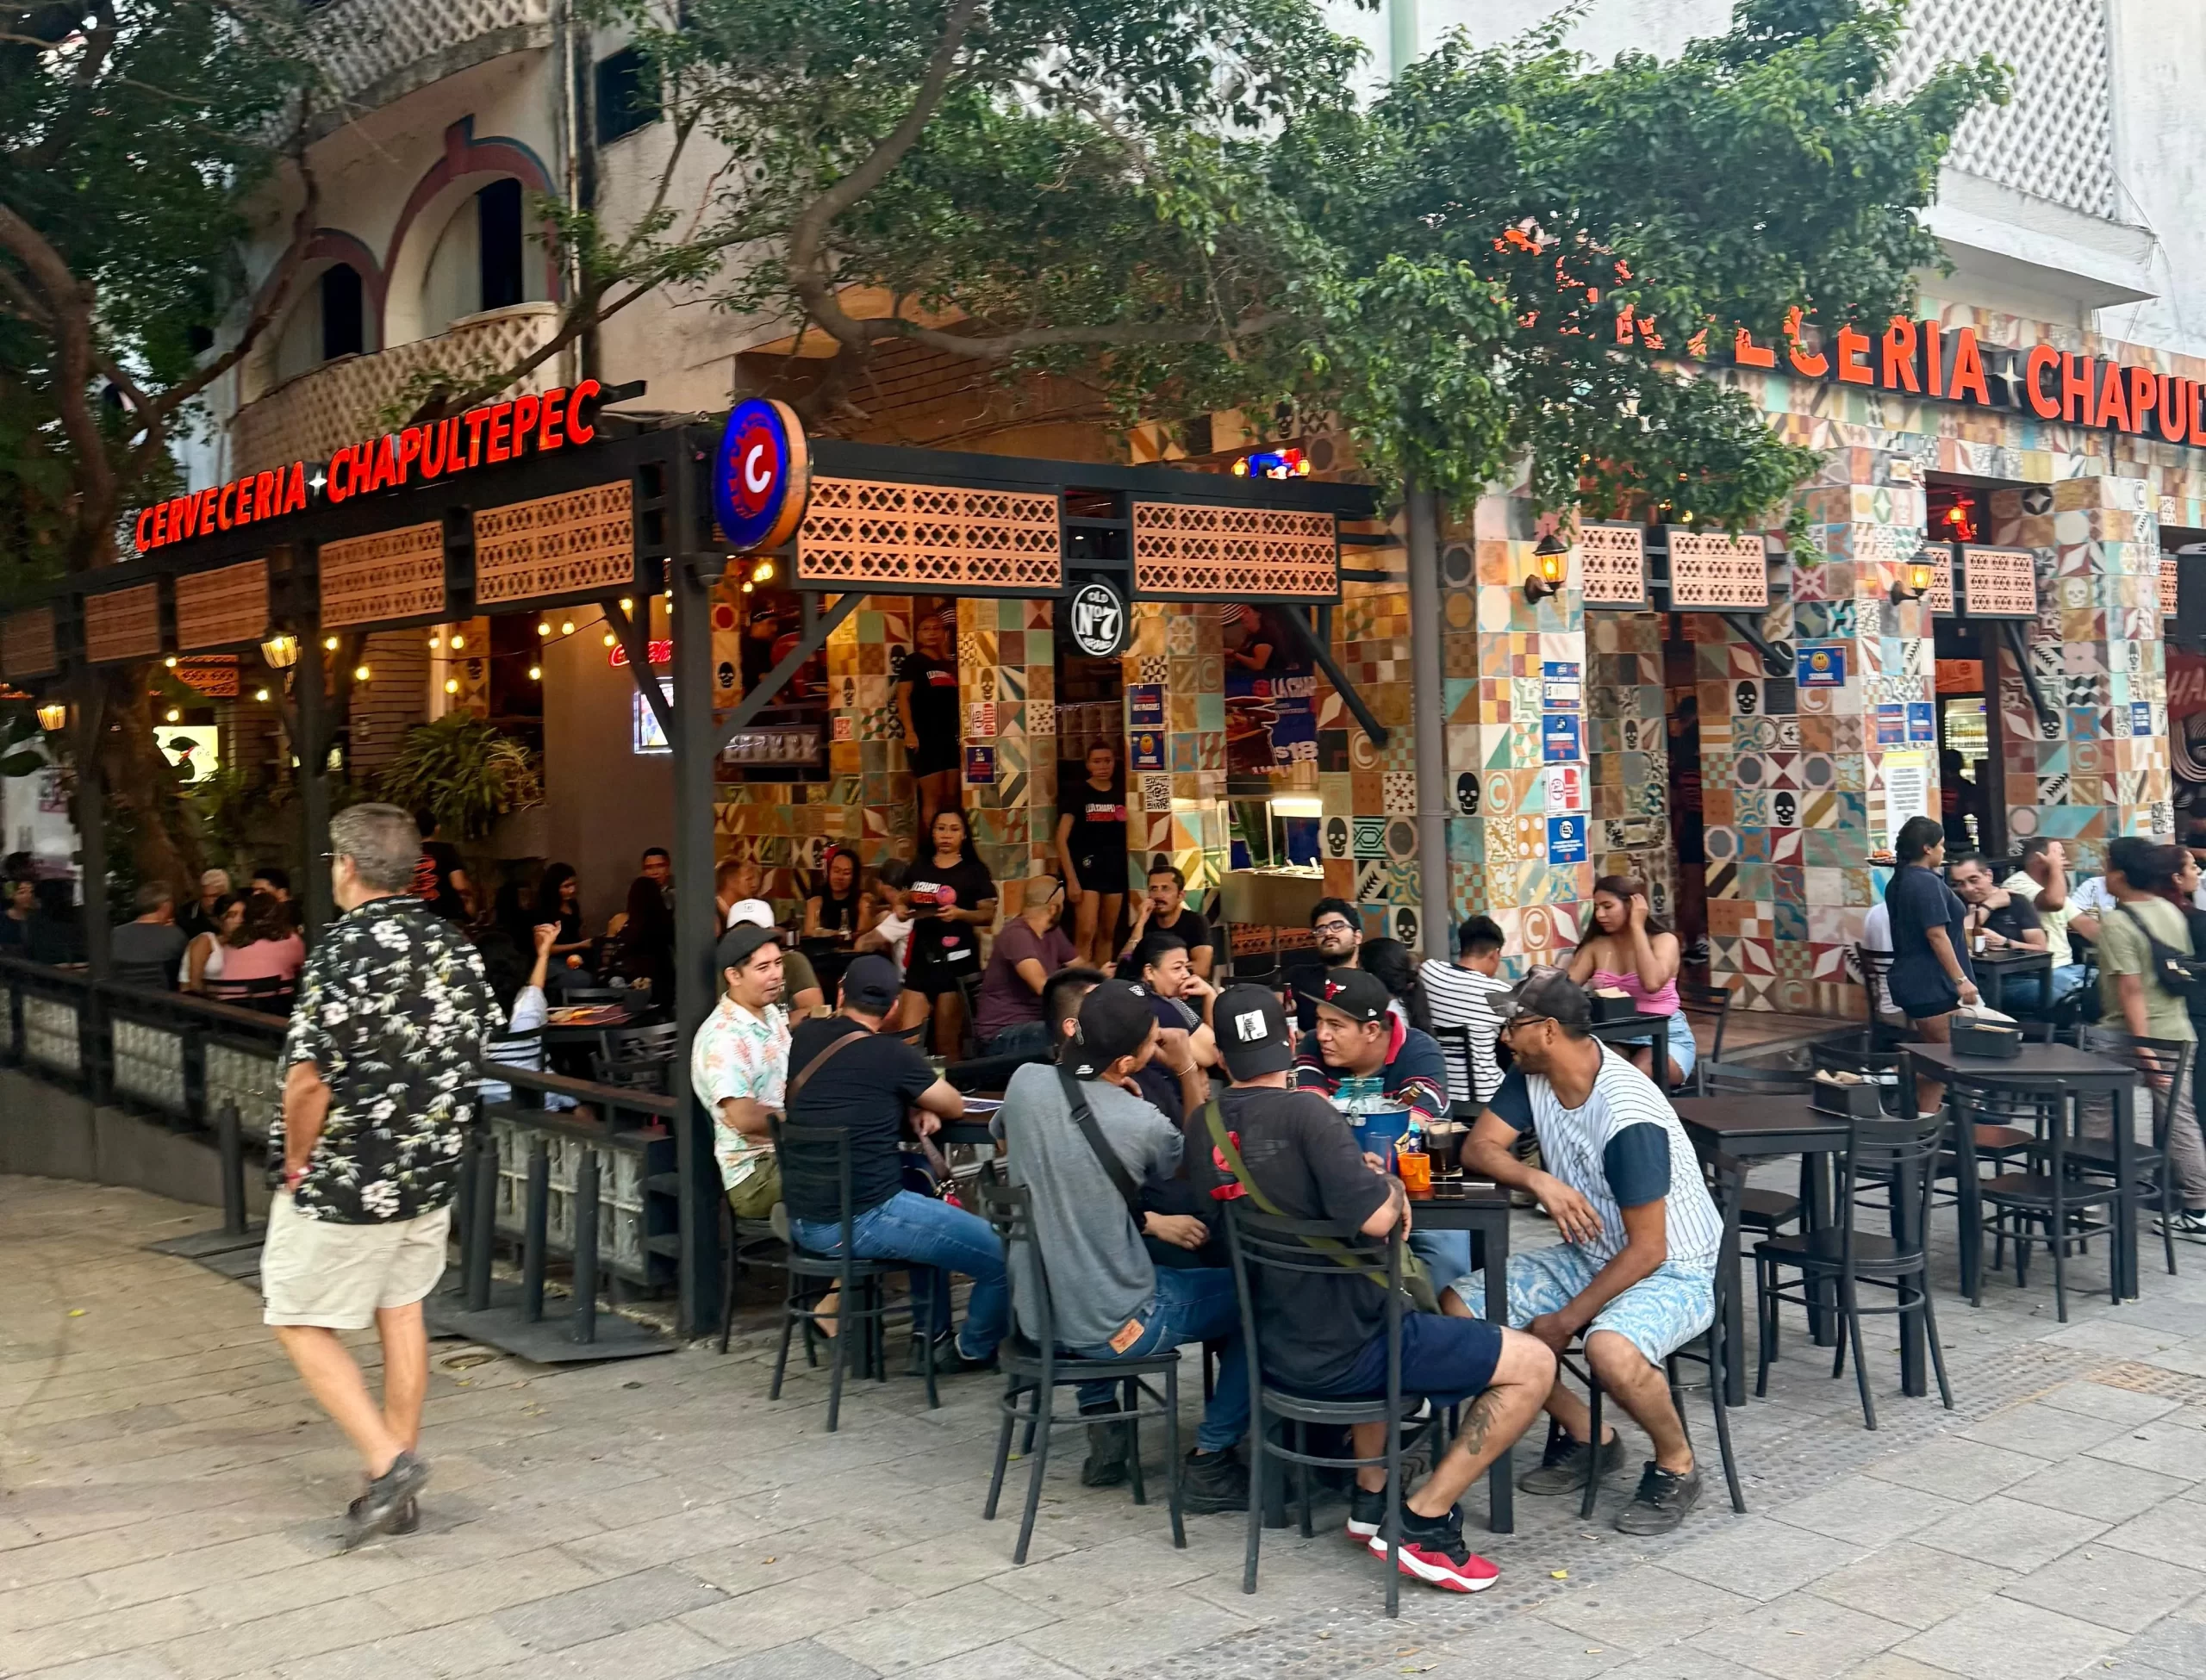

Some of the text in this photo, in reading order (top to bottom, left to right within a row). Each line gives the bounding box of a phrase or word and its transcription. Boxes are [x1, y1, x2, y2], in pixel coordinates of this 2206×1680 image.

[2027, 344, 2206, 447] CHAPUL
[135, 461, 306, 552] CERVECERIA
[327, 378, 601, 504] CHAPULTEPEC
[745, 444, 772, 493] C
